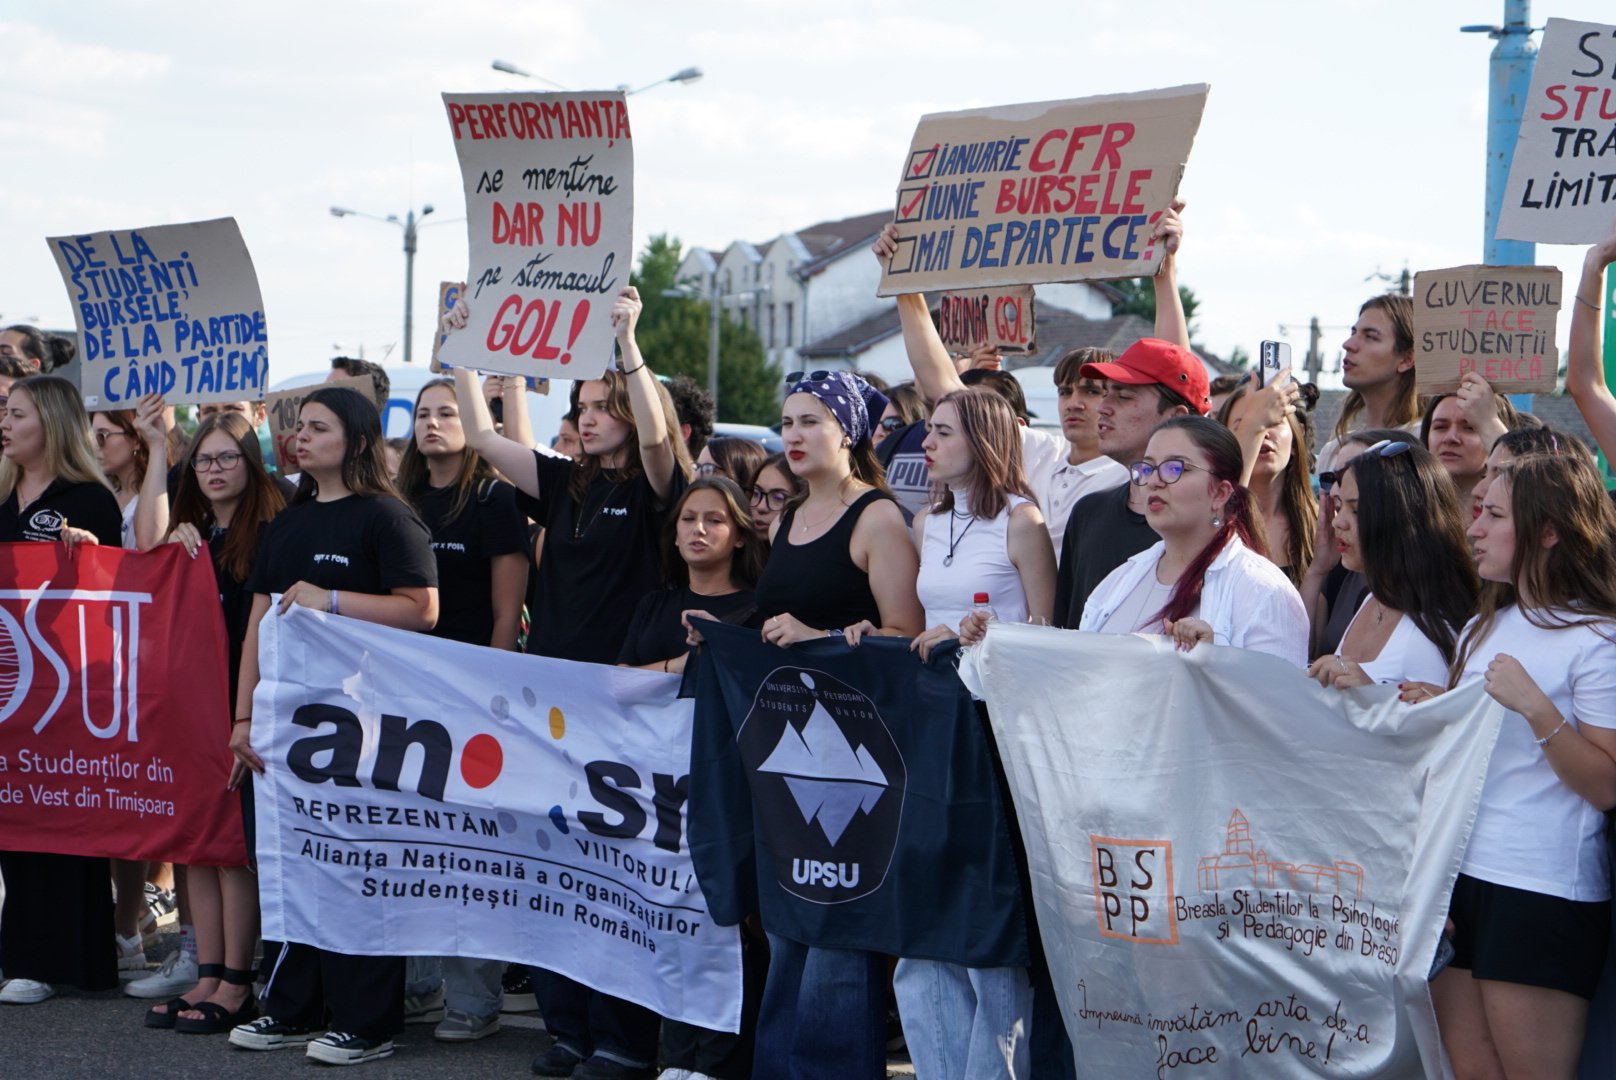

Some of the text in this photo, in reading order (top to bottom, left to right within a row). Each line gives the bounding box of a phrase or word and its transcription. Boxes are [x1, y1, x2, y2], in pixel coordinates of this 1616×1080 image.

[1571, 31, 1616, 80] S
[448, 100, 632, 148] PERFORMANȚA
[1028, 121, 1136, 174] CFR
[476, 154, 619, 199] se menține
[994, 169, 1153, 215] BURSELE
[492, 201, 602, 247] DAR NU
[58, 230, 158, 274] DE LA
[474, 265, 504, 300] pe
[511, 252, 618, 294] stomacul
[1425, 280, 1559, 308] GUVERNUL
[80, 291, 188, 330] BURSELE,
[486, 293, 591, 365] GOL!
[1458, 309, 1536, 332] TACE
[84, 329, 116, 361] DE
[122, 323, 162, 358] LA
[104, 360, 177, 402] CÂND
[18, 748, 140, 783] Studenților
[147, 756, 174, 783] din
[0, 782, 175, 818] de Vest din Timișoara
[294, 797, 693, 894] REPREZENTĂM VIITORUL!
[300, 838, 700, 937] Alianța Națională a Organizațiilor
[791, 858, 859, 888] UPSU
[361, 877, 657, 954] Studențești din România
[1175, 892, 1227, 921] Breasla
[1231, 889, 1303, 918] Studenților
[1308, 894, 1320, 918] la
[1243, 913, 1328, 956] Pedagogie
[1335, 925, 1354, 950] din
[1361, 928, 1400, 967] Brașo
[1147, 1002, 1242, 1033] învățăm
[1254, 992, 1311, 1021] arta
[1156, 1018, 1336, 1080] face bine!
